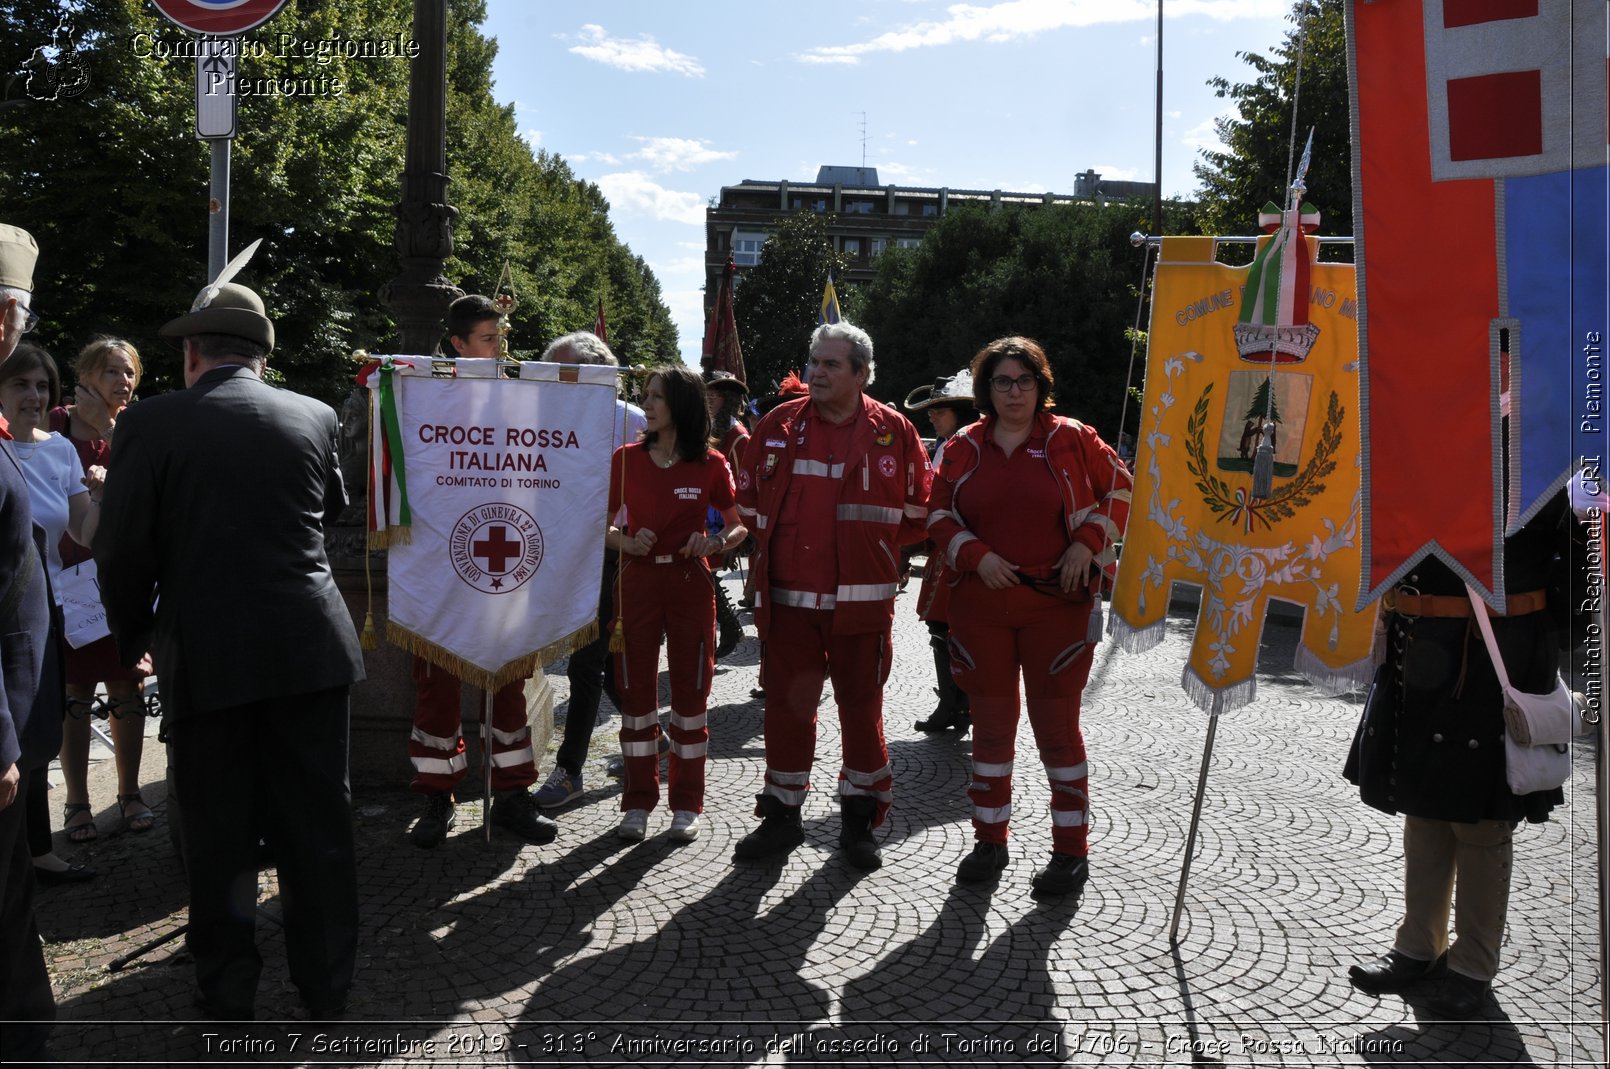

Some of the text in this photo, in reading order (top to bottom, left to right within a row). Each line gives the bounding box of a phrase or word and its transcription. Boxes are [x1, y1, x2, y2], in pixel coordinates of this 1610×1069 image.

[1175, 288, 1235, 326] COMUNE
[418, 423, 580, 449] CROCE ROSSA
[449, 451, 548, 473] ITALIANA
[436, 475, 561, 489] COMITATO DI TORINO
[453, 506, 540, 583] CONVENZIONE DI GINEVRA 22 AGOSTO 1864
